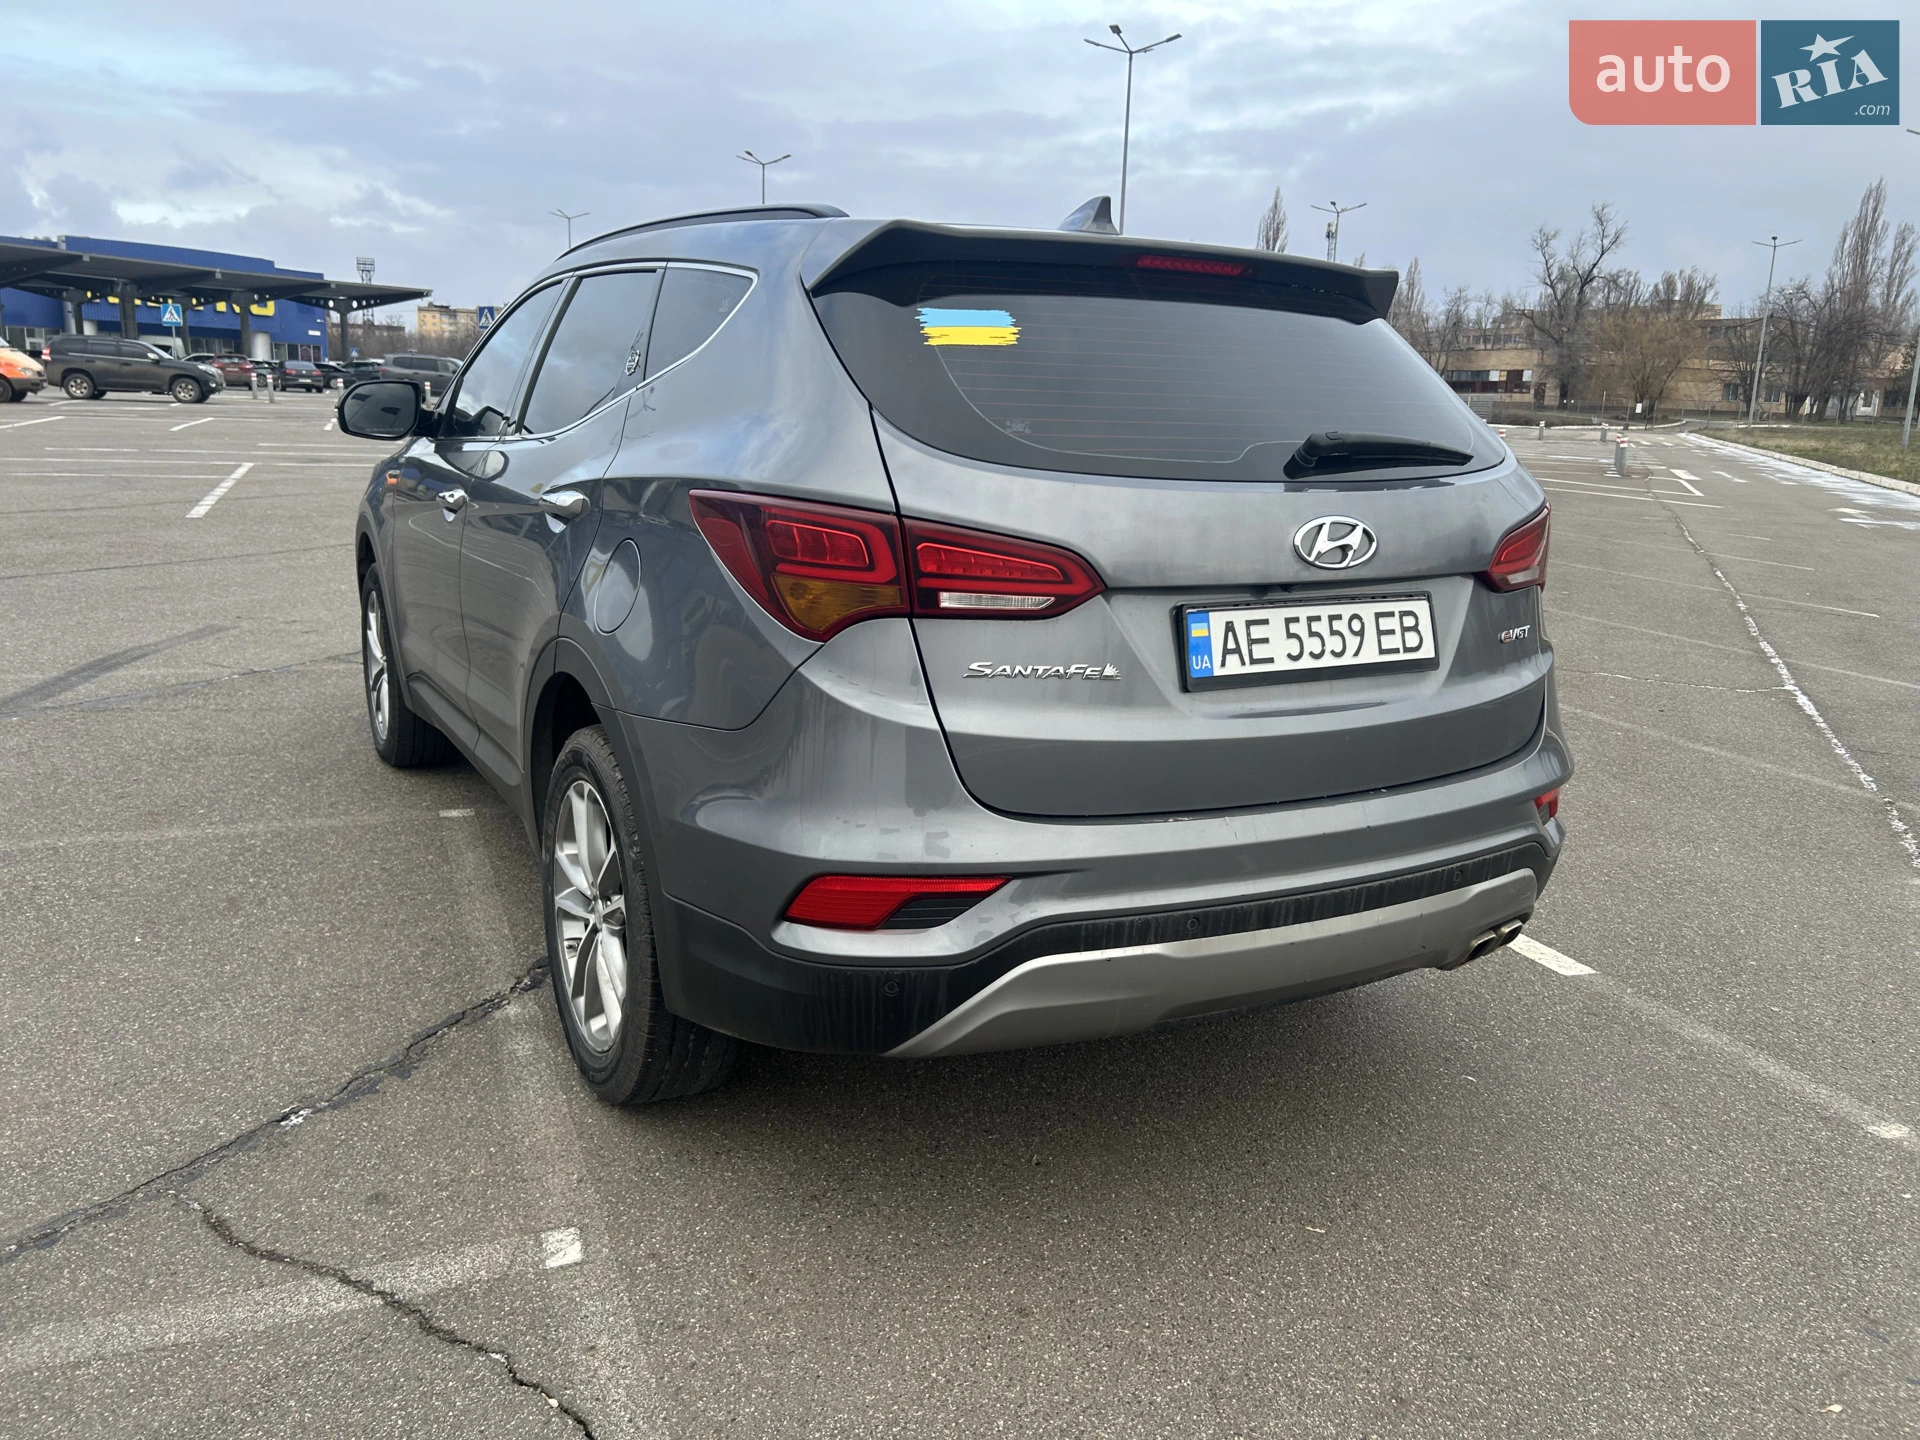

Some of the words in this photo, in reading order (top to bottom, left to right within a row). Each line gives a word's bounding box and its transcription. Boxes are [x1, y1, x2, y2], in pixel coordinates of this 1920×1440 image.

[1220, 618, 1275, 668] AE
[1284, 613, 1366, 662] 5559
[1374, 610, 1424, 656] EB
[1192, 655, 1212, 670] UA
